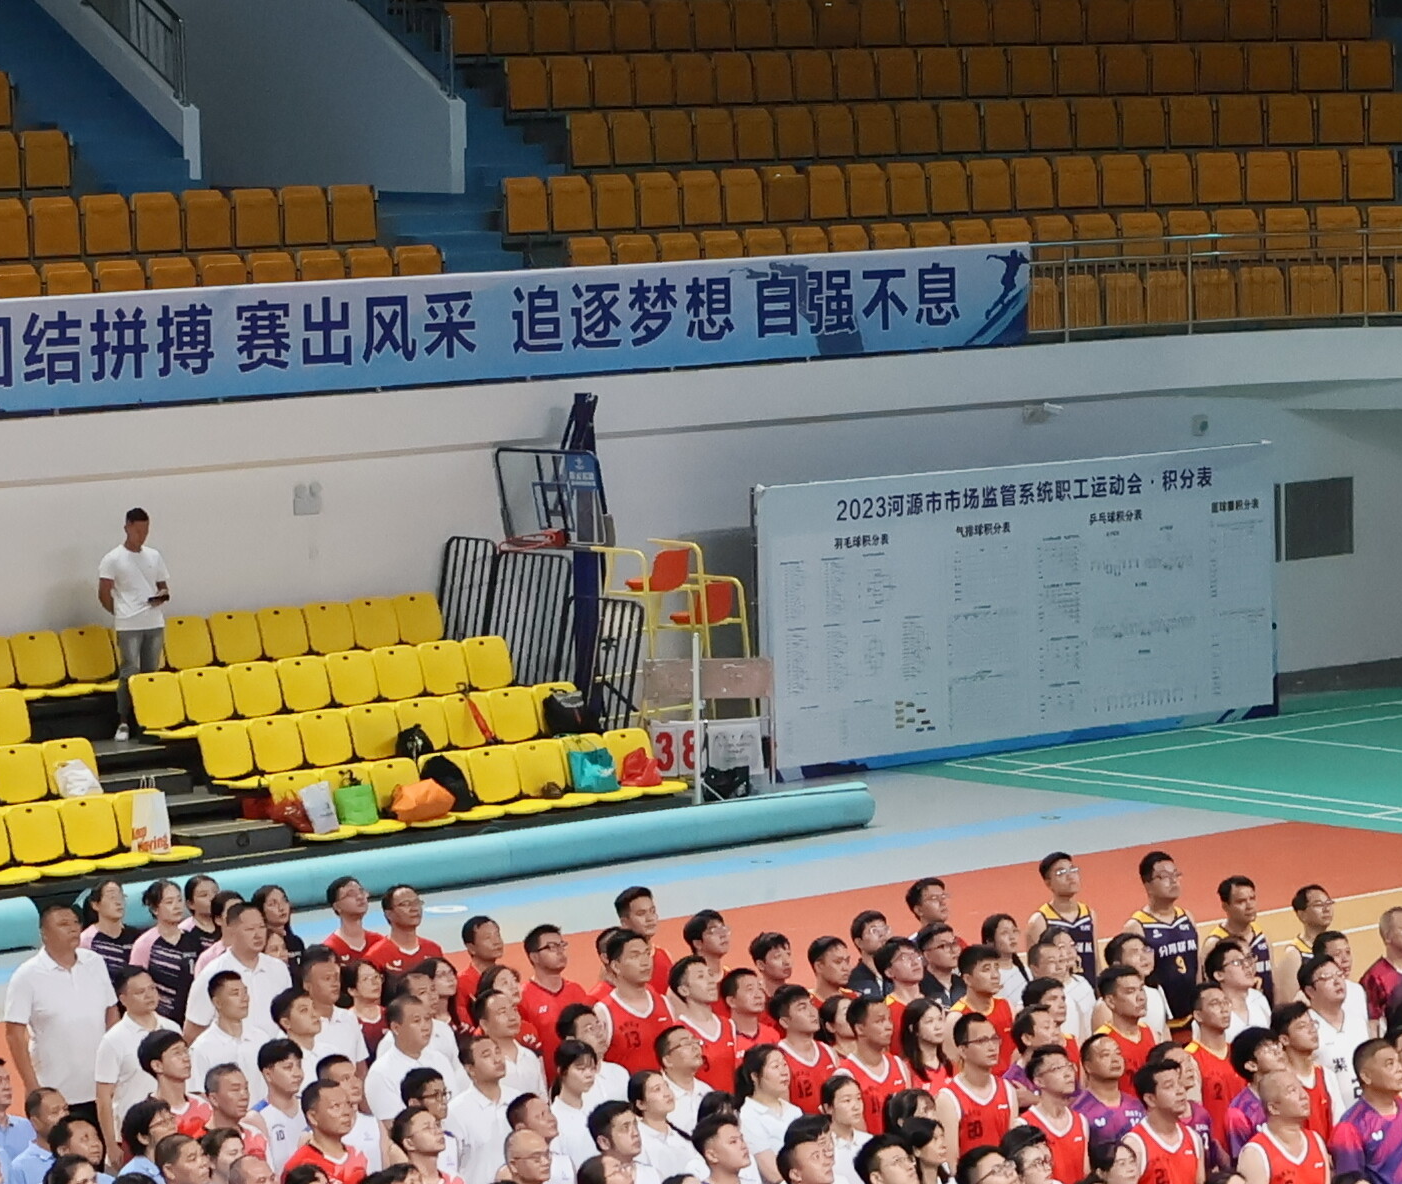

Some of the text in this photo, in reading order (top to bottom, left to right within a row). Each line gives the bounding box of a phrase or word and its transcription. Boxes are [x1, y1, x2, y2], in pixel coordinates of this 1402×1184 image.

[234, 290, 479, 373] 赛出风采
[511, 274, 737, 353] 追逐梦想
[754, 261, 964, 339] 自强不息
